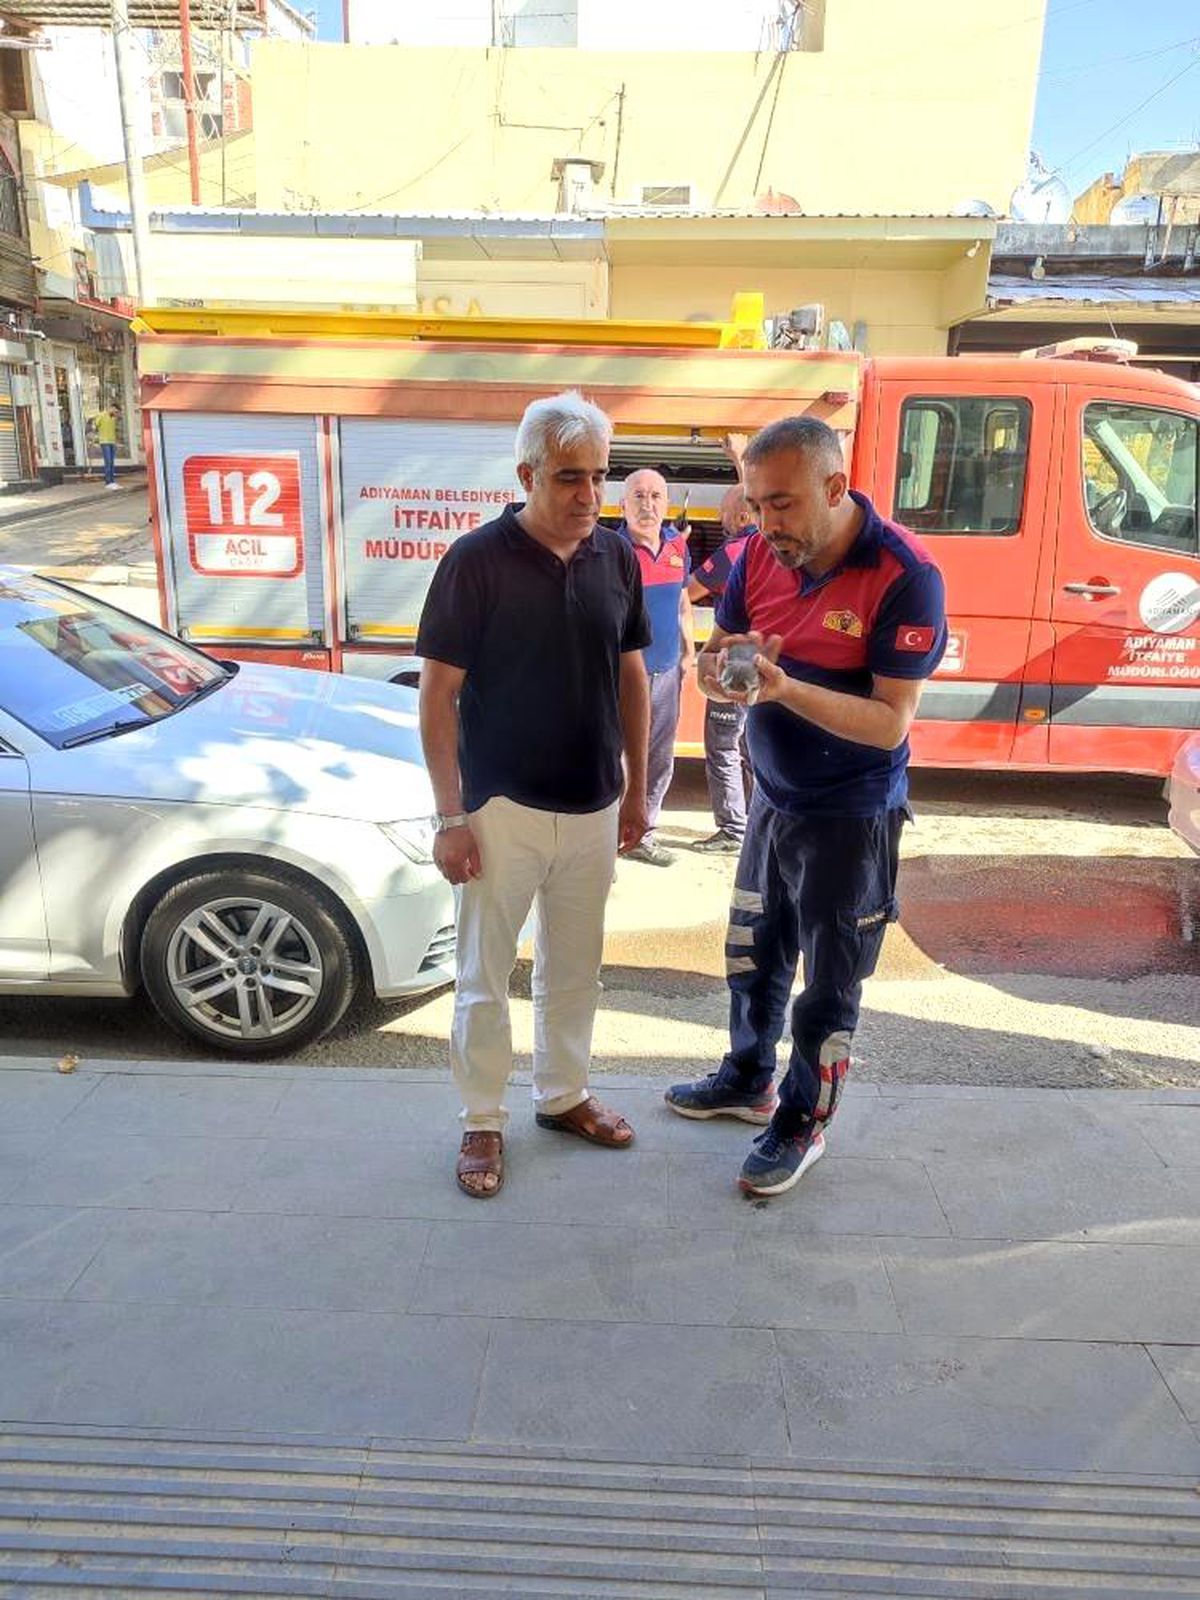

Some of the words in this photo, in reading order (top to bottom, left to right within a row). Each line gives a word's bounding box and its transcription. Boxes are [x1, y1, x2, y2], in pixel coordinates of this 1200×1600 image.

[201, 470, 284, 526] 112
[360, 486, 431, 500] ADIYAMAN
[394, 505, 481, 530] İTFAİYE
[366, 537, 448, 560] MÜDÜR
[1124, 636, 1196, 650] ADIYAMAN
